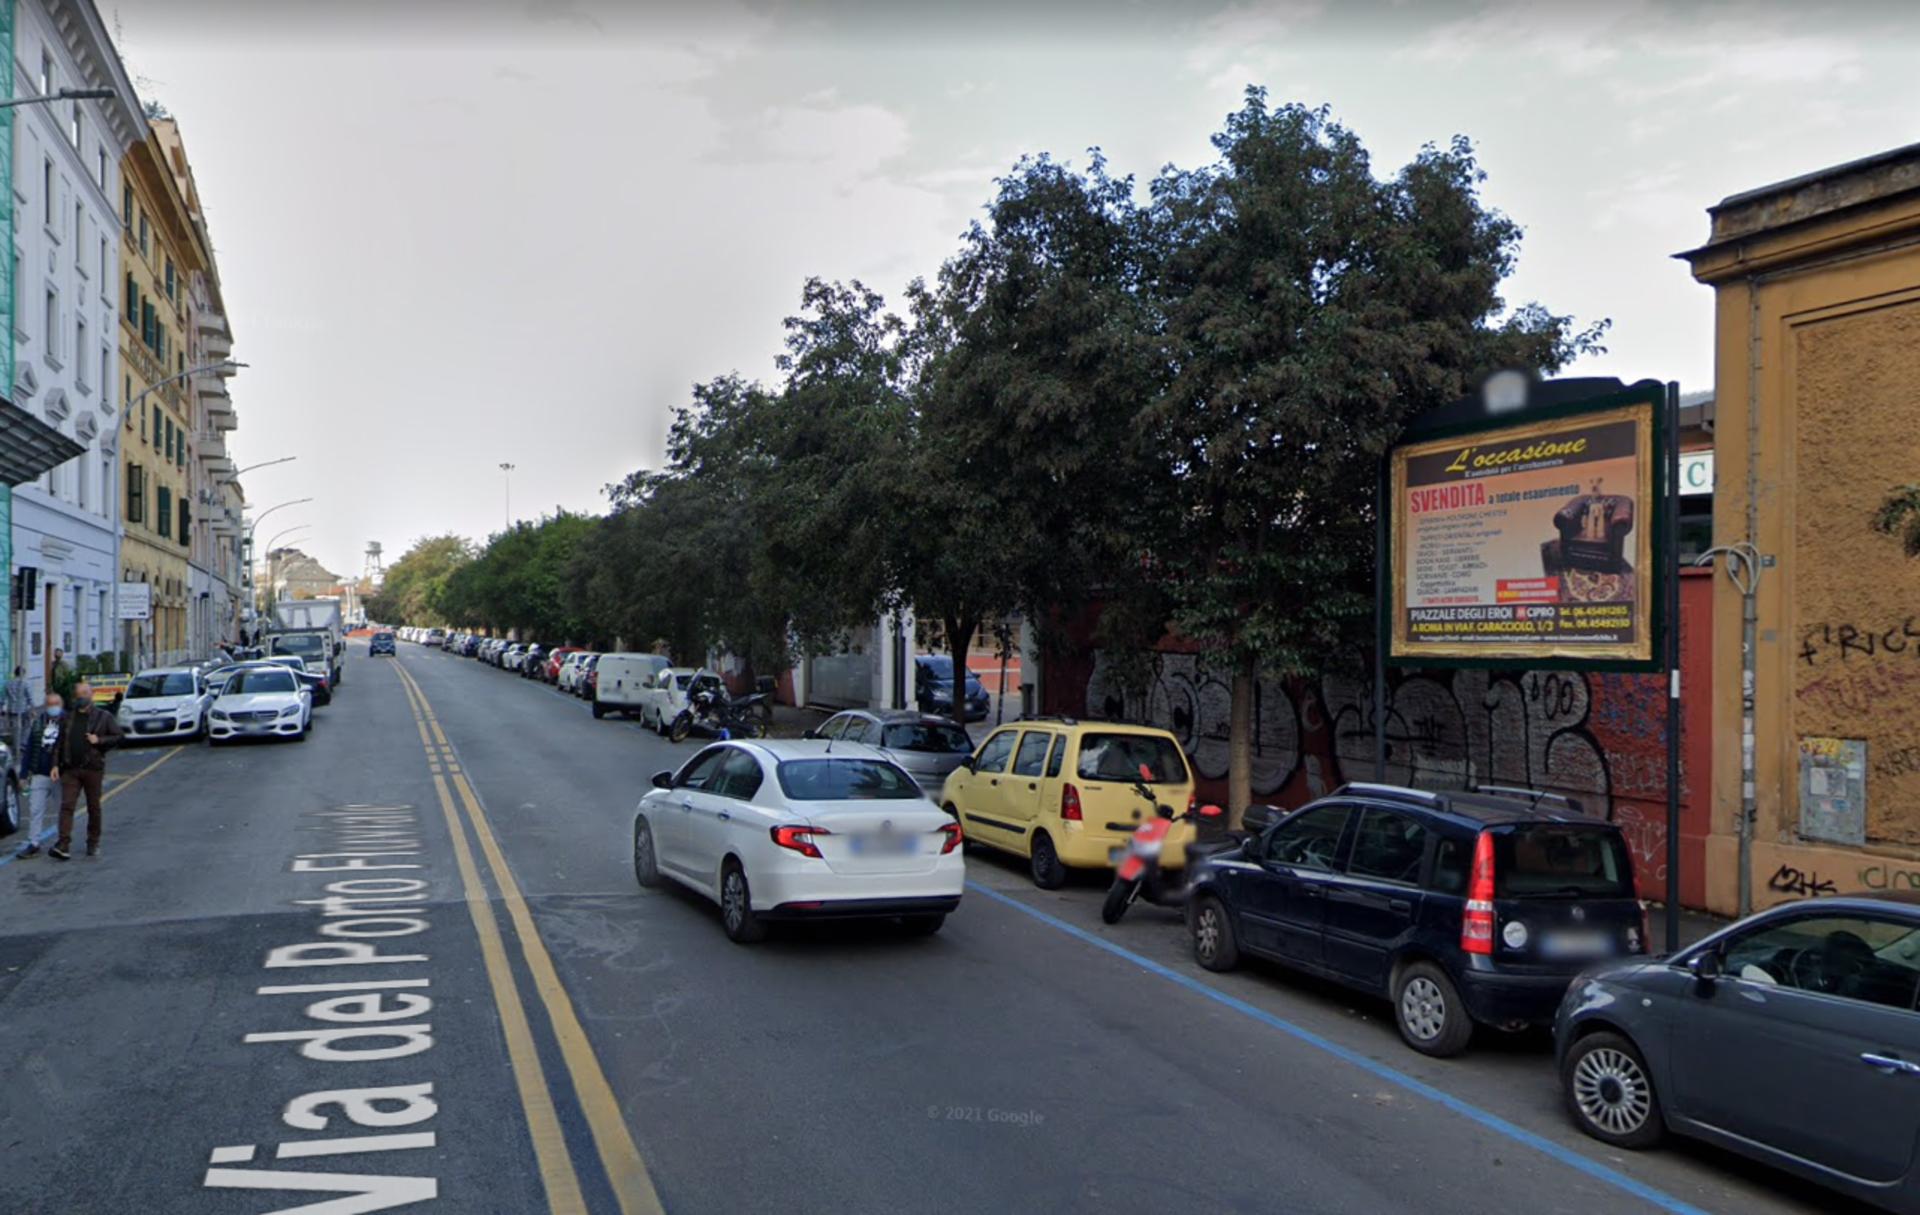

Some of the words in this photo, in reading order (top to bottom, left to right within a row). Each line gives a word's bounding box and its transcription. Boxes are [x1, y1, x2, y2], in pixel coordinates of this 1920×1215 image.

[1444, 436, 1587, 473] L'occasione
[1411, 483, 1485, 514] SVENDITA
[1488, 494, 1495, 505] a
[1496, 489, 1522, 504] totale
[1523, 484, 1580, 502] esaurimento
[1411, 608, 1456, 621] PIAZZALE
[1457, 608, 1485, 620] DEGLI
[1487, 607, 1513, 620] EROI
[1526, 606, 1555, 618] CIPRO
[1419, 622, 1443, 632] ROMA
[1477, 621, 1536, 633] CARACCIOLO,
